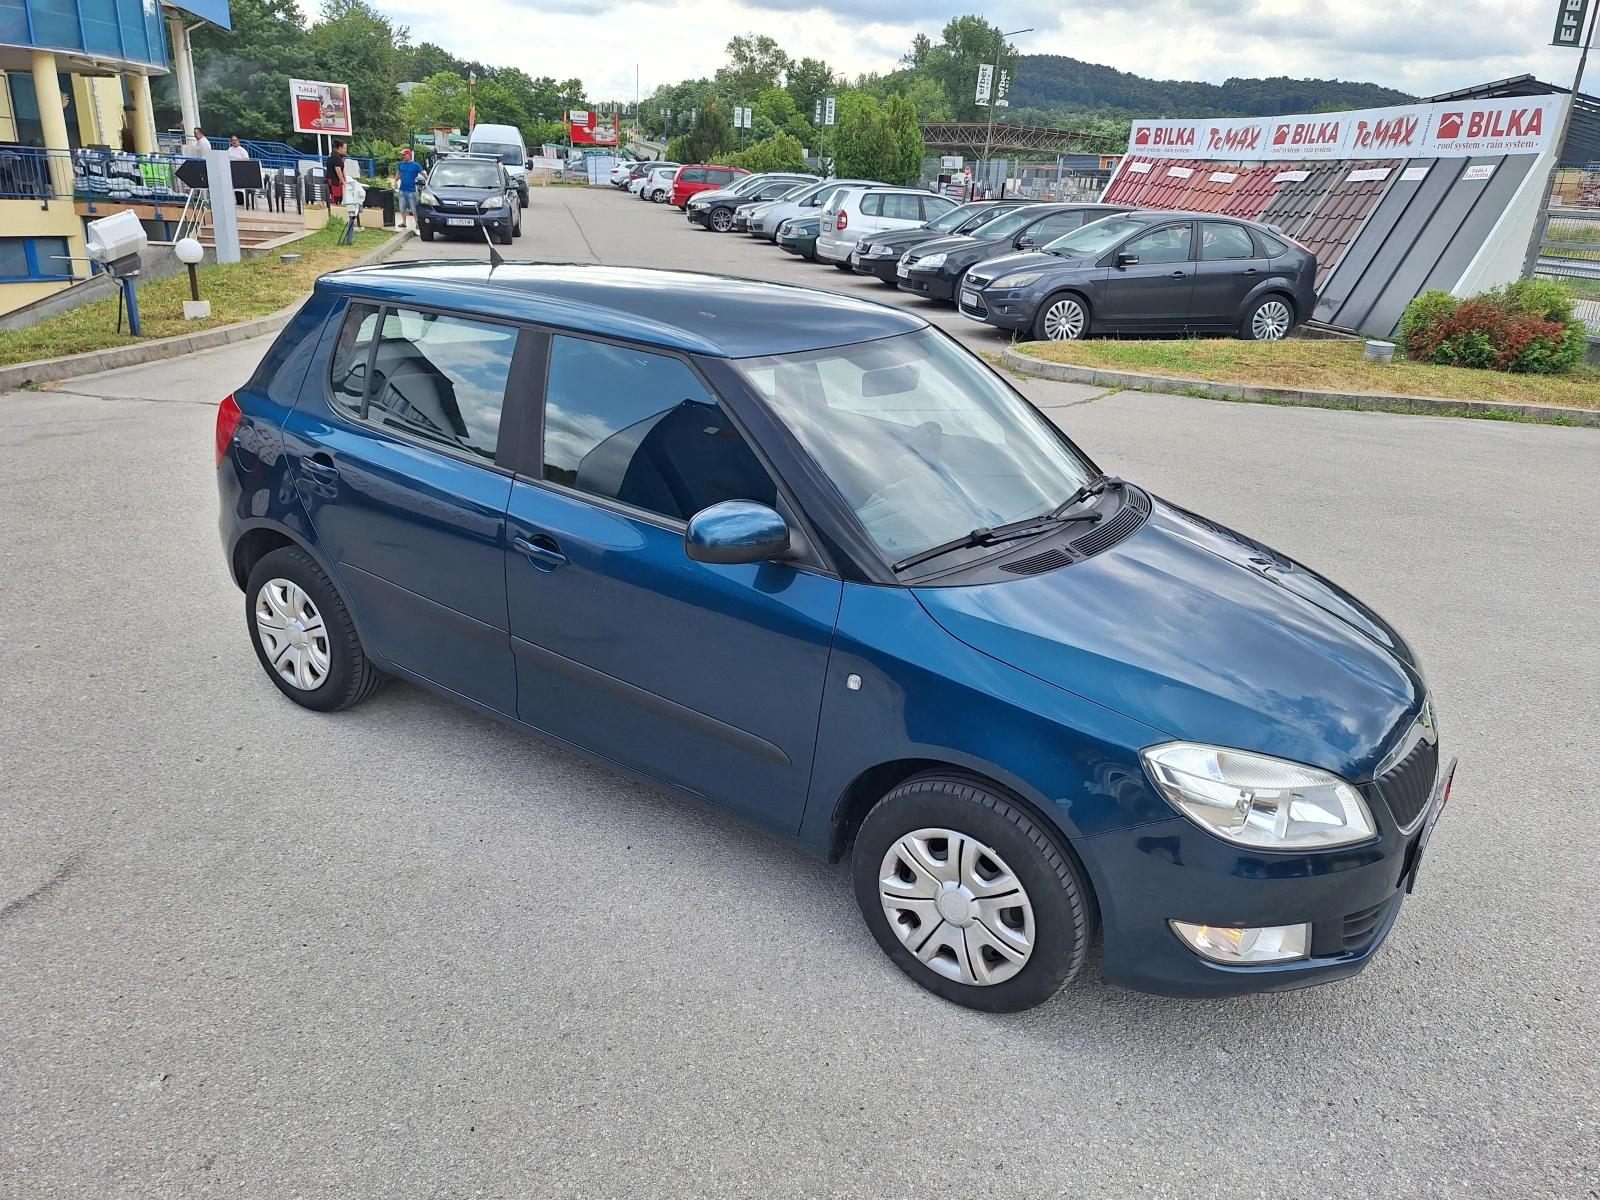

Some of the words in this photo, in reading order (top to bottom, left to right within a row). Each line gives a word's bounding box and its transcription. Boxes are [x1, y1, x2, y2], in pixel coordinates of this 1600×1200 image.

[978, 66, 988, 95] efbet
[997, 69, 1008, 98] efbet
[1291, 122, 1340, 145] BILKA
[1353, 116, 1419, 151] TeMAX
[1467, 107, 1543, 138] BILKA
[1153, 127, 1195, 146] BILKA
[1206, 126, 1262, 152] TeMAX
[1437, 141, 1456, 150] roof
[1454, 142, 1480, 151] system
[1486, 139, 1503, 149] rain
[1503, 141, 1534, 151] system
